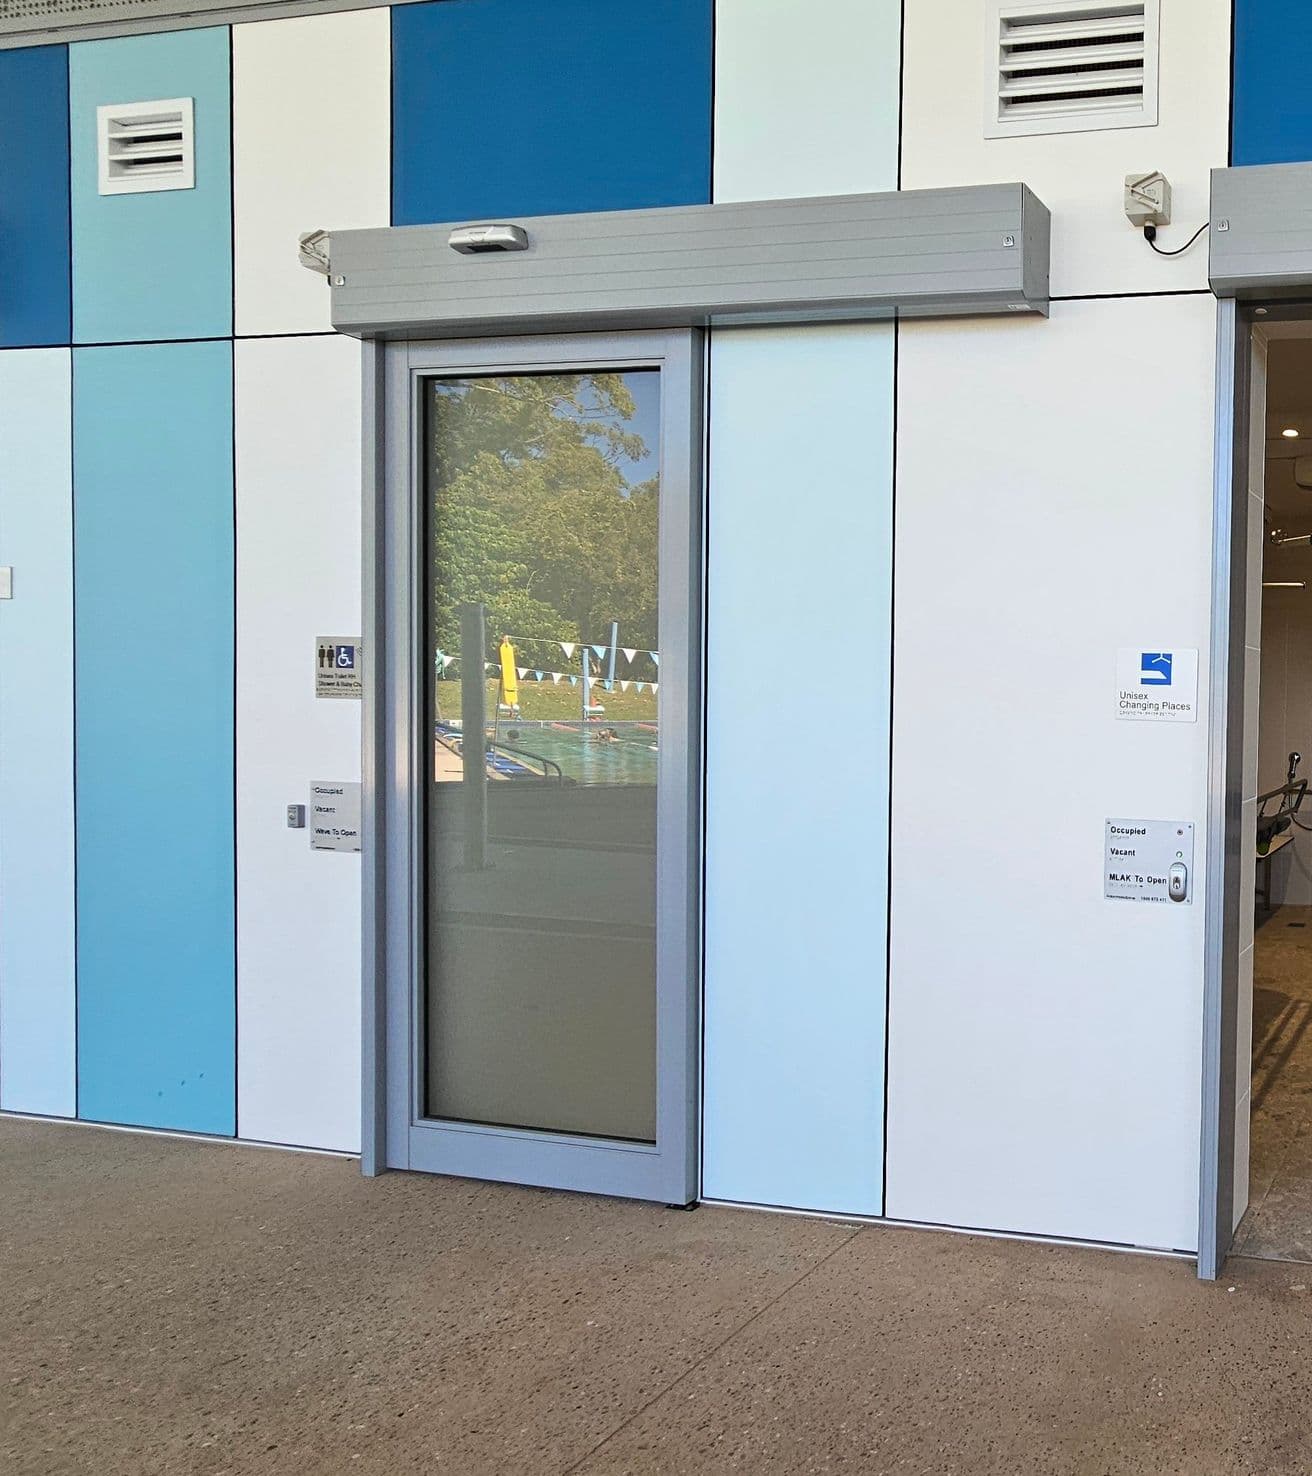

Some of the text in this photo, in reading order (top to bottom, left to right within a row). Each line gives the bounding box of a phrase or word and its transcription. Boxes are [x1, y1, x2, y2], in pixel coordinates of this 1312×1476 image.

[1119, 691, 1149, 700] Unisex
[1119, 700, 1191, 711] Changing Places
[314, 787, 344, 795] Occupied
[315, 805, 336, 813] Vacant
[1110, 826, 1146, 836] Occupied
[1110, 848, 1136, 856] Vacant
[1109, 873, 1131, 882] MLAK
[1147, 876, 1167, 884] Open
